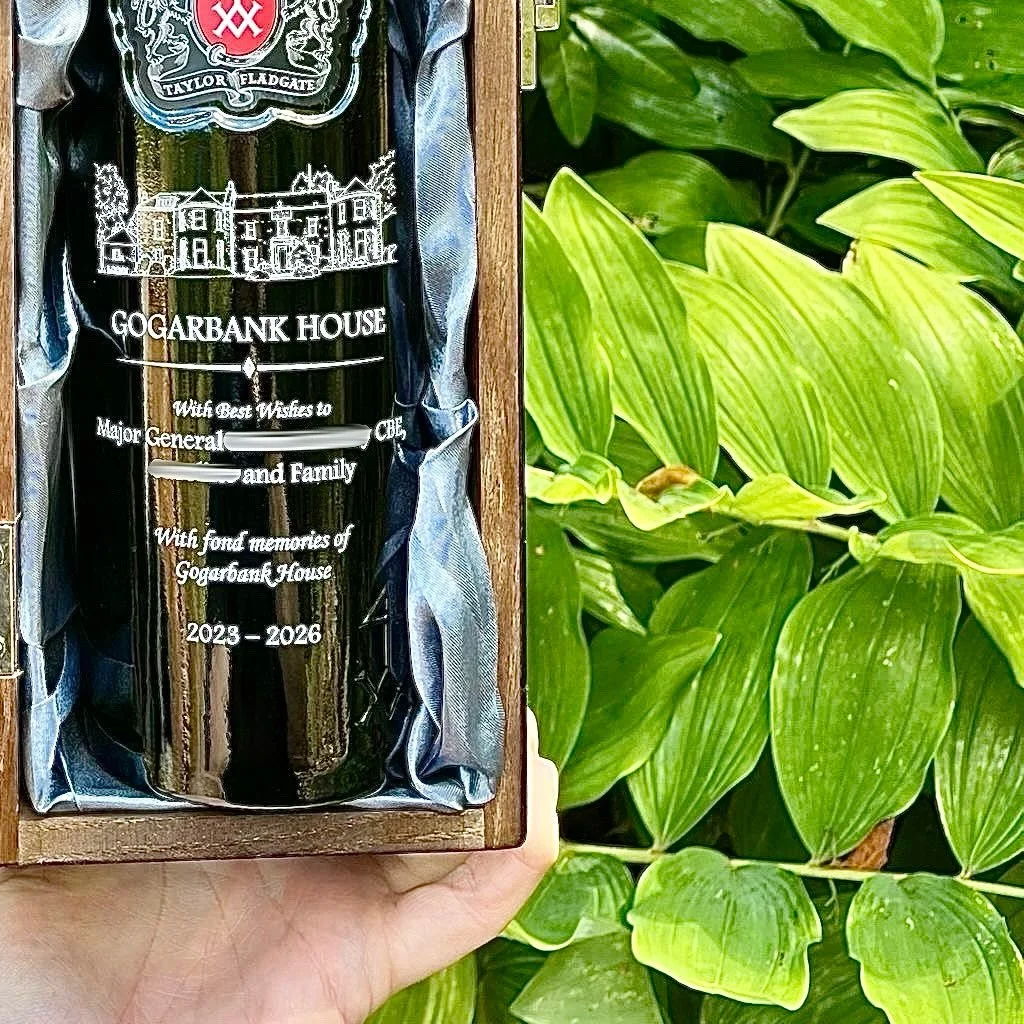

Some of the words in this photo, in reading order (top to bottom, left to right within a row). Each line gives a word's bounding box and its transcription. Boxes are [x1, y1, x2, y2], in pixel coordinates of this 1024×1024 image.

[163, 74, 228, 97] TAYLOR
[239, 74, 316, 92] FLADGATE
[111, 309, 291, 343] GOGARBANK
[296, 307, 387, 340] HOUSE
[173, 399, 213, 419] With
[215, 403, 253, 419] Best
[256, 401, 315, 420] Wishes
[316, 401, 333, 418] to
[96, 417, 142, 447] Major
[144, 426, 225, 452] General
[375, 416, 407, 442] CBE,
[241, 461, 285, 484] and
[290, 458, 357, 484] Family
[154, 526, 199, 549] With
[197, 529, 246, 556] fond
[248, 529, 331, 553] memories
[333, 524, 355, 553] of
[175, 561, 278, 587] Gogarbank
[275, 561, 333, 583] House
[185, 622, 241, 646] 2023
[264, 623, 323, 646] 2026
